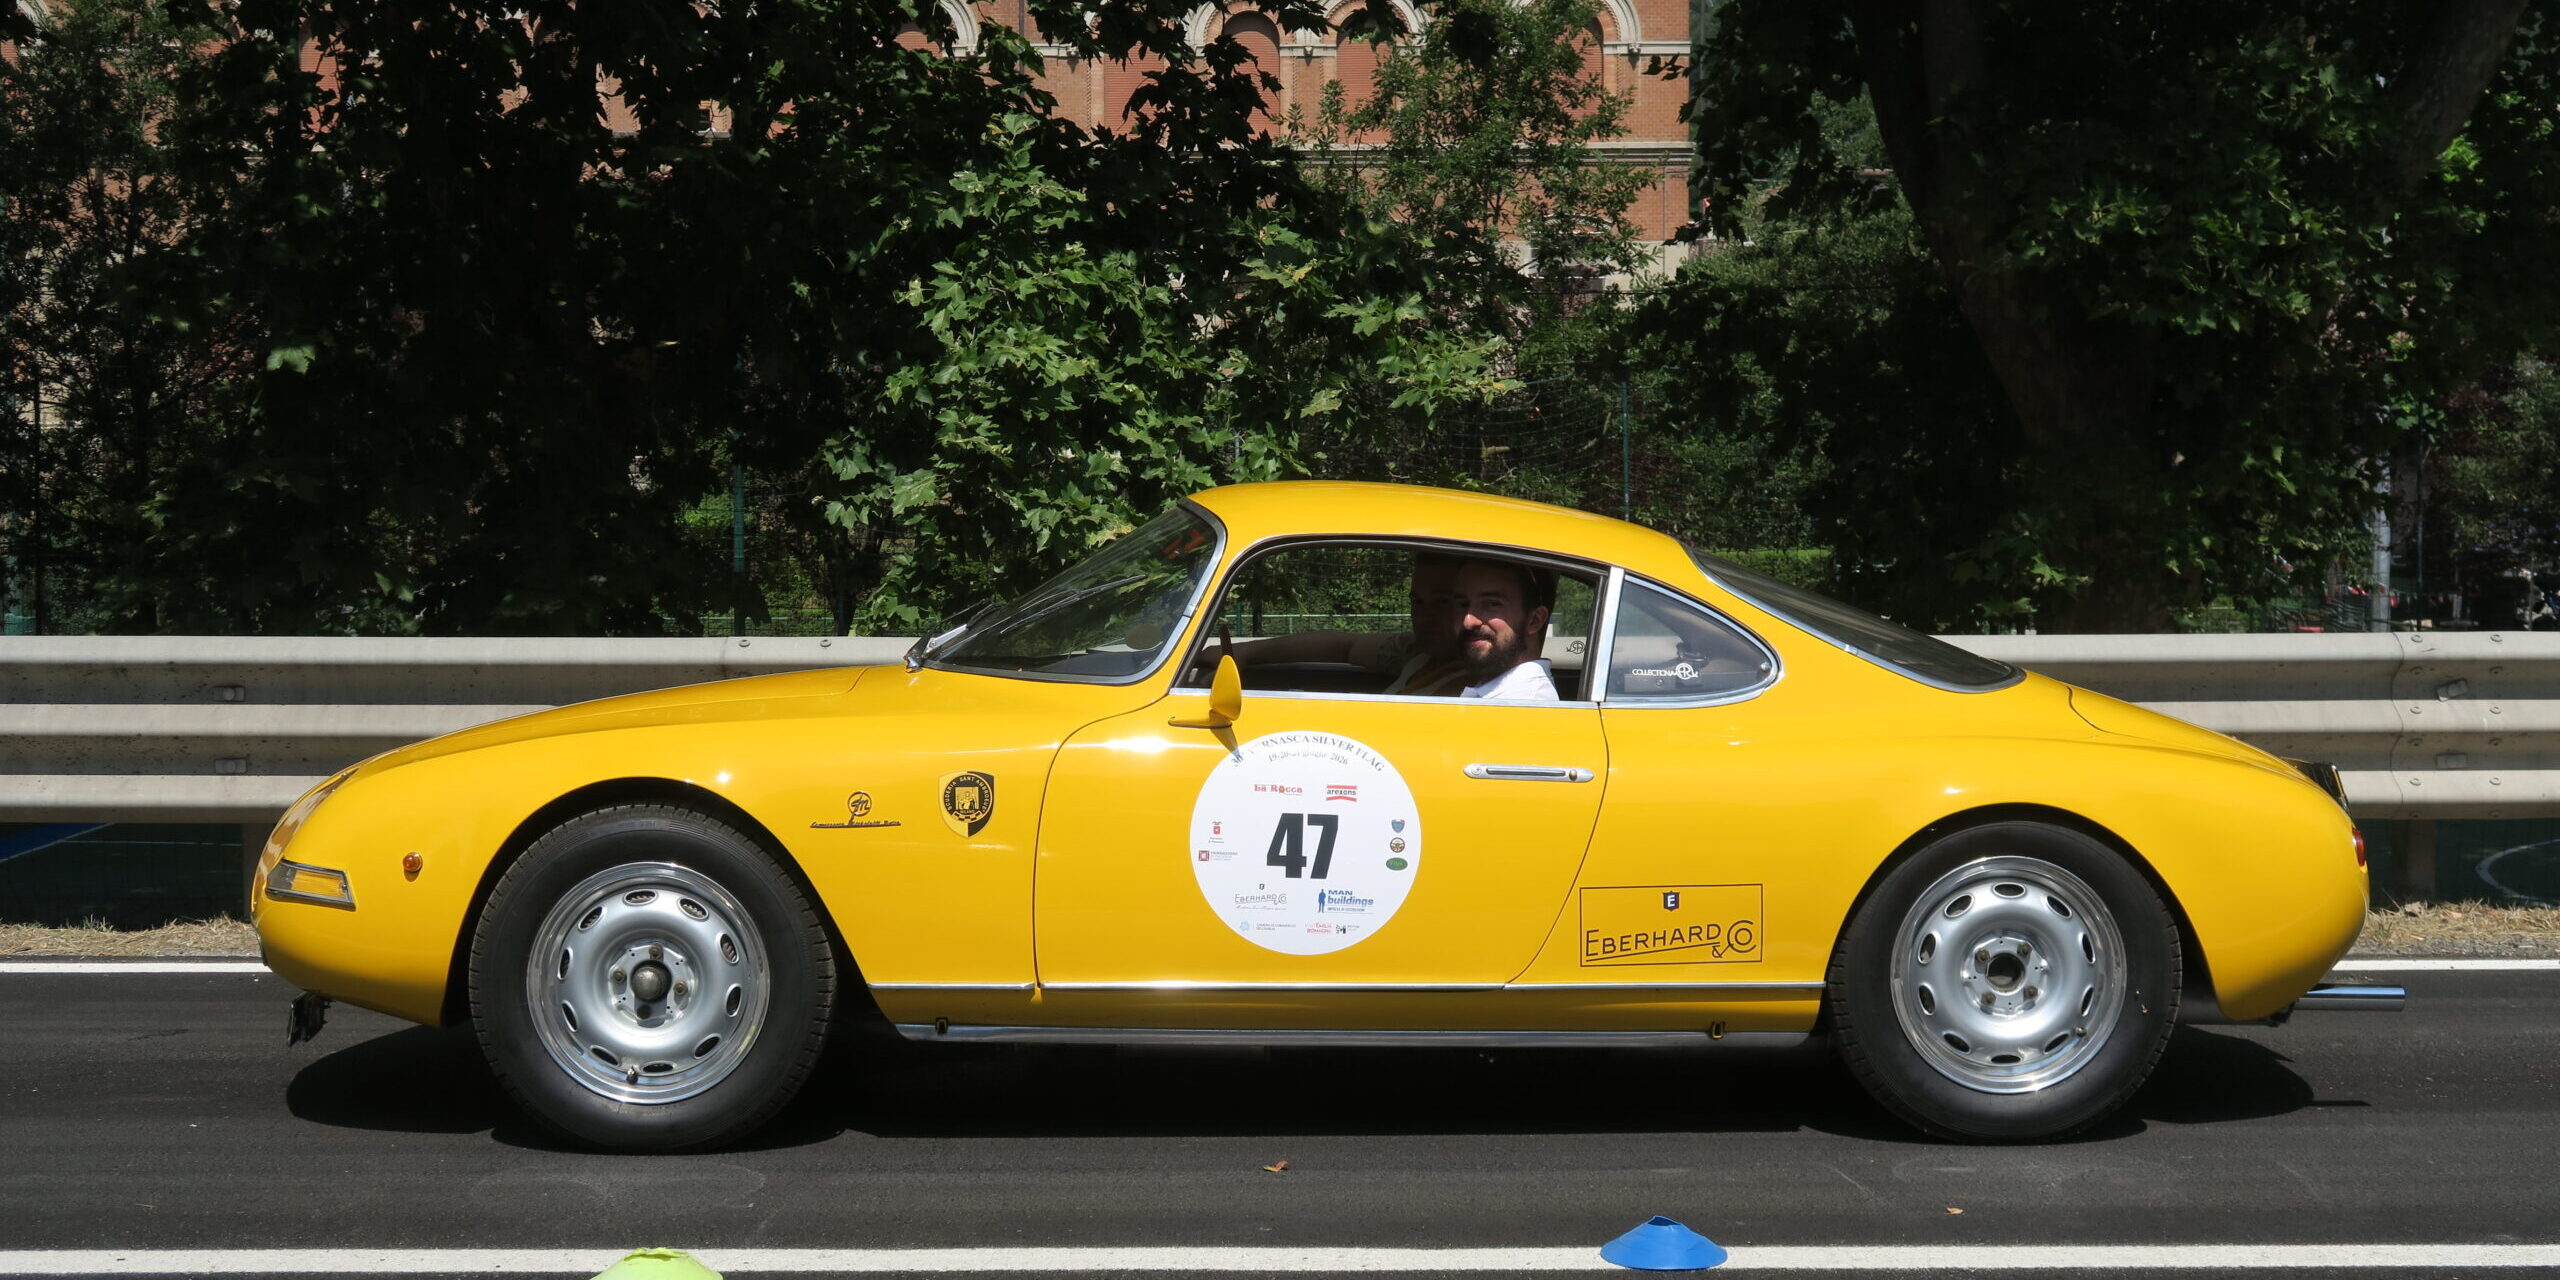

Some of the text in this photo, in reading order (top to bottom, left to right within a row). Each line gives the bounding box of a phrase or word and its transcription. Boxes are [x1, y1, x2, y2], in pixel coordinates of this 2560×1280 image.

[1311, 735, 1354, 752] SILVER
[1355, 747, 1384, 772] FLAG
[1330, 752, 1348, 766] 2026
[945, 781, 957, 811] SCUDERIA
[1326, 788, 1356, 796] arexons
[1266, 812, 1339, 880] 47
[1327, 895, 1374, 907] buildings
[1667, 894, 1675, 907] E
[1586, 923, 1722, 957] EBERHARD
